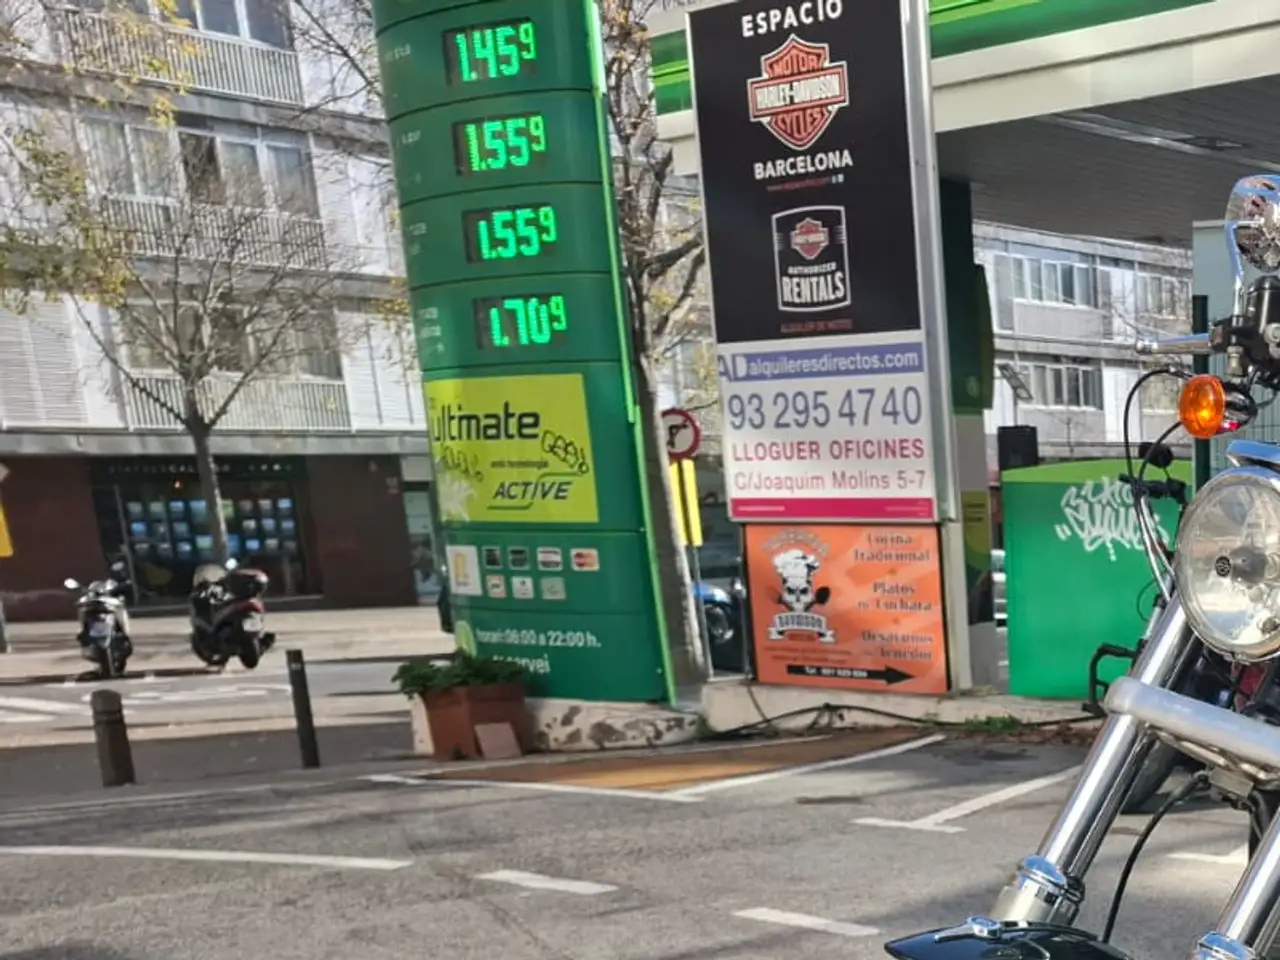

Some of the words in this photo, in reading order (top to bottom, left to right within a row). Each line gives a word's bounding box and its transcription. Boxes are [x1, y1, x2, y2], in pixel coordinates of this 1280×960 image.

[741, 0, 843, 38] ESPACIO
[770, 49, 820, 77] MOTOR
[753, 149, 853, 180] BARCELONA
[781, 271, 845, 304] RENTALS
[750, 351, 919, 379] alquileresdirectos.com
[728, 393, 766, 430] 93
[772, 389, 831, 429] 295
[733, 440, 821, 463] LLOGUER
[829, 438, 925, 461] OFICINES
[493, 480, 574, 501] ACTIVE
[734, 470, 825, 494] C/Joaquim
[832, 469, 891, 490] Molins
[896, 469, 927, 490] 5-7
[549, 630, 585, 647] 22:00
